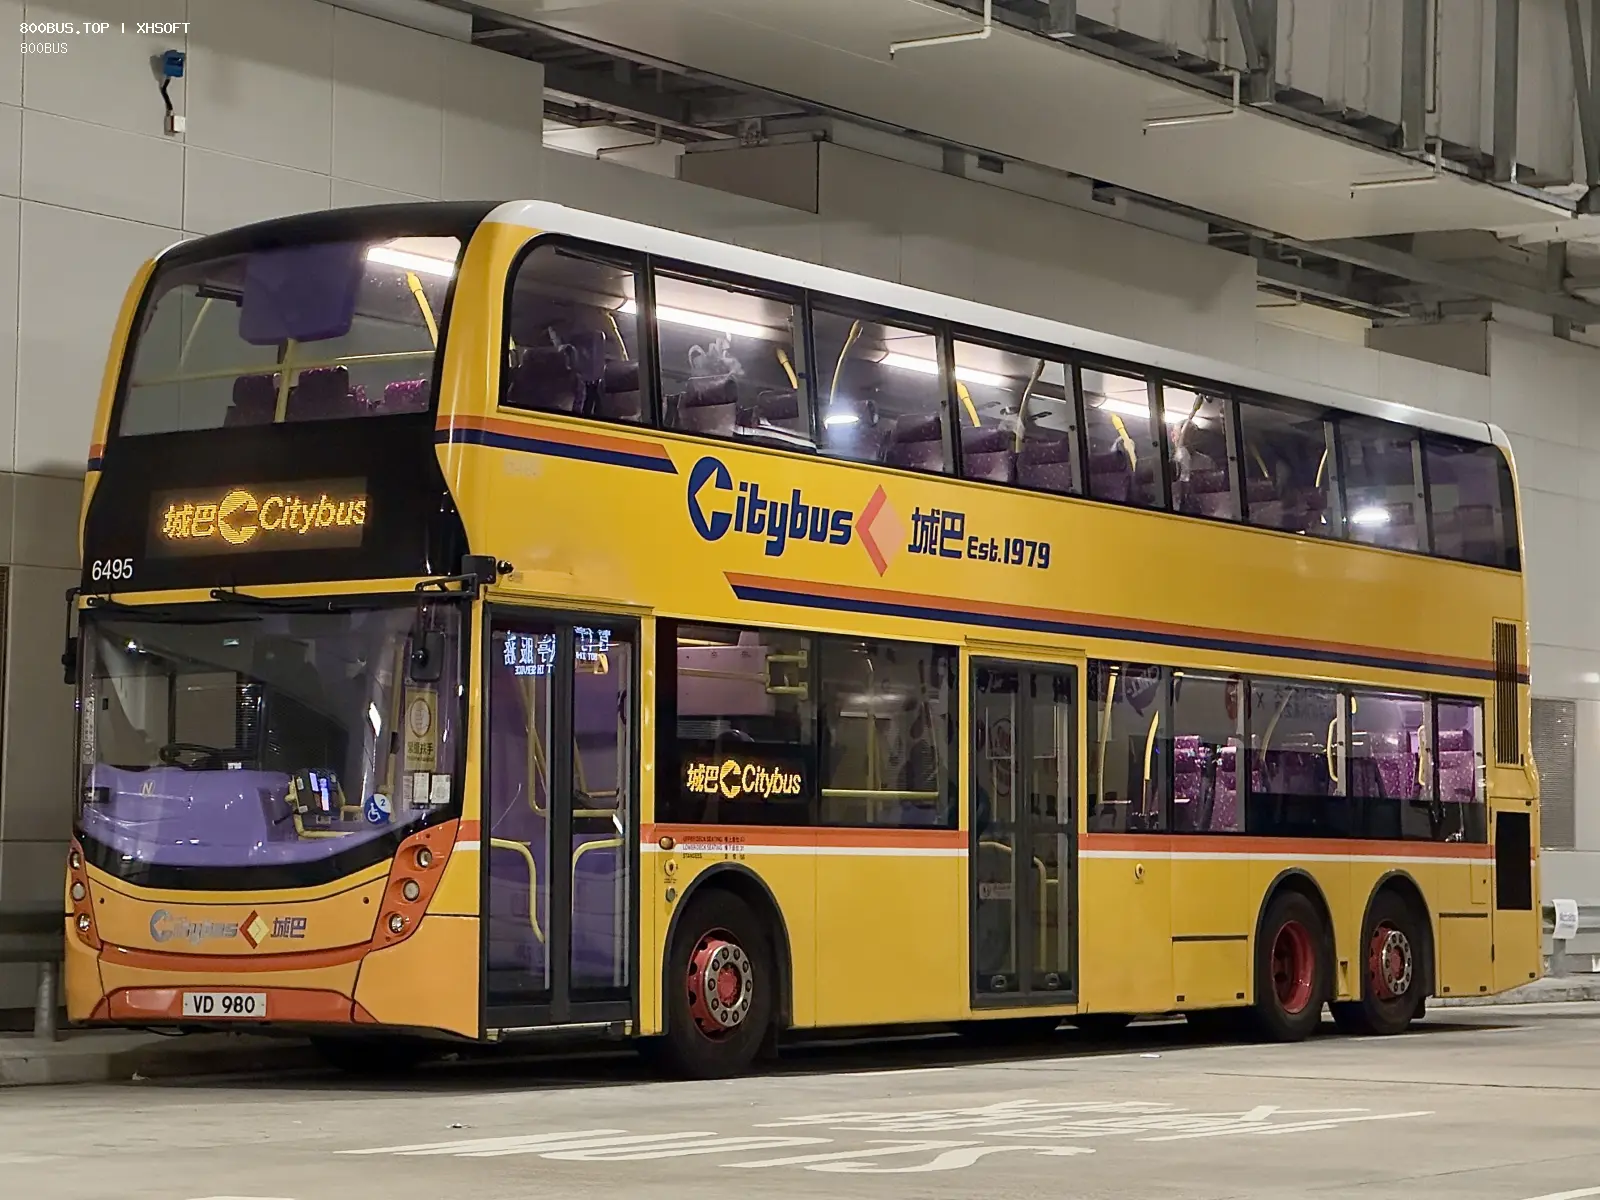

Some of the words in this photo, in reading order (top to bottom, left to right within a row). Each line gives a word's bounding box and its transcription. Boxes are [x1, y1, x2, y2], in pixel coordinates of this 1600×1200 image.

[162, 503, 217, 538] 城巴
[259, 494, 368, 535] Citybus
[687, 456, 854, 557] Citybus
[907, 506, 966, 559] 城巴
[91, 558, 133, 581] 6495
[686, 763, 719, 793] 城巴
[742, 764, 801, 798] Citybus
[380, 798, 386, 807] 2
[270, 917, 307, 939] 城巴
[193, 995, 214, 1014] VD
[221, 995, 256, 1014] 980
